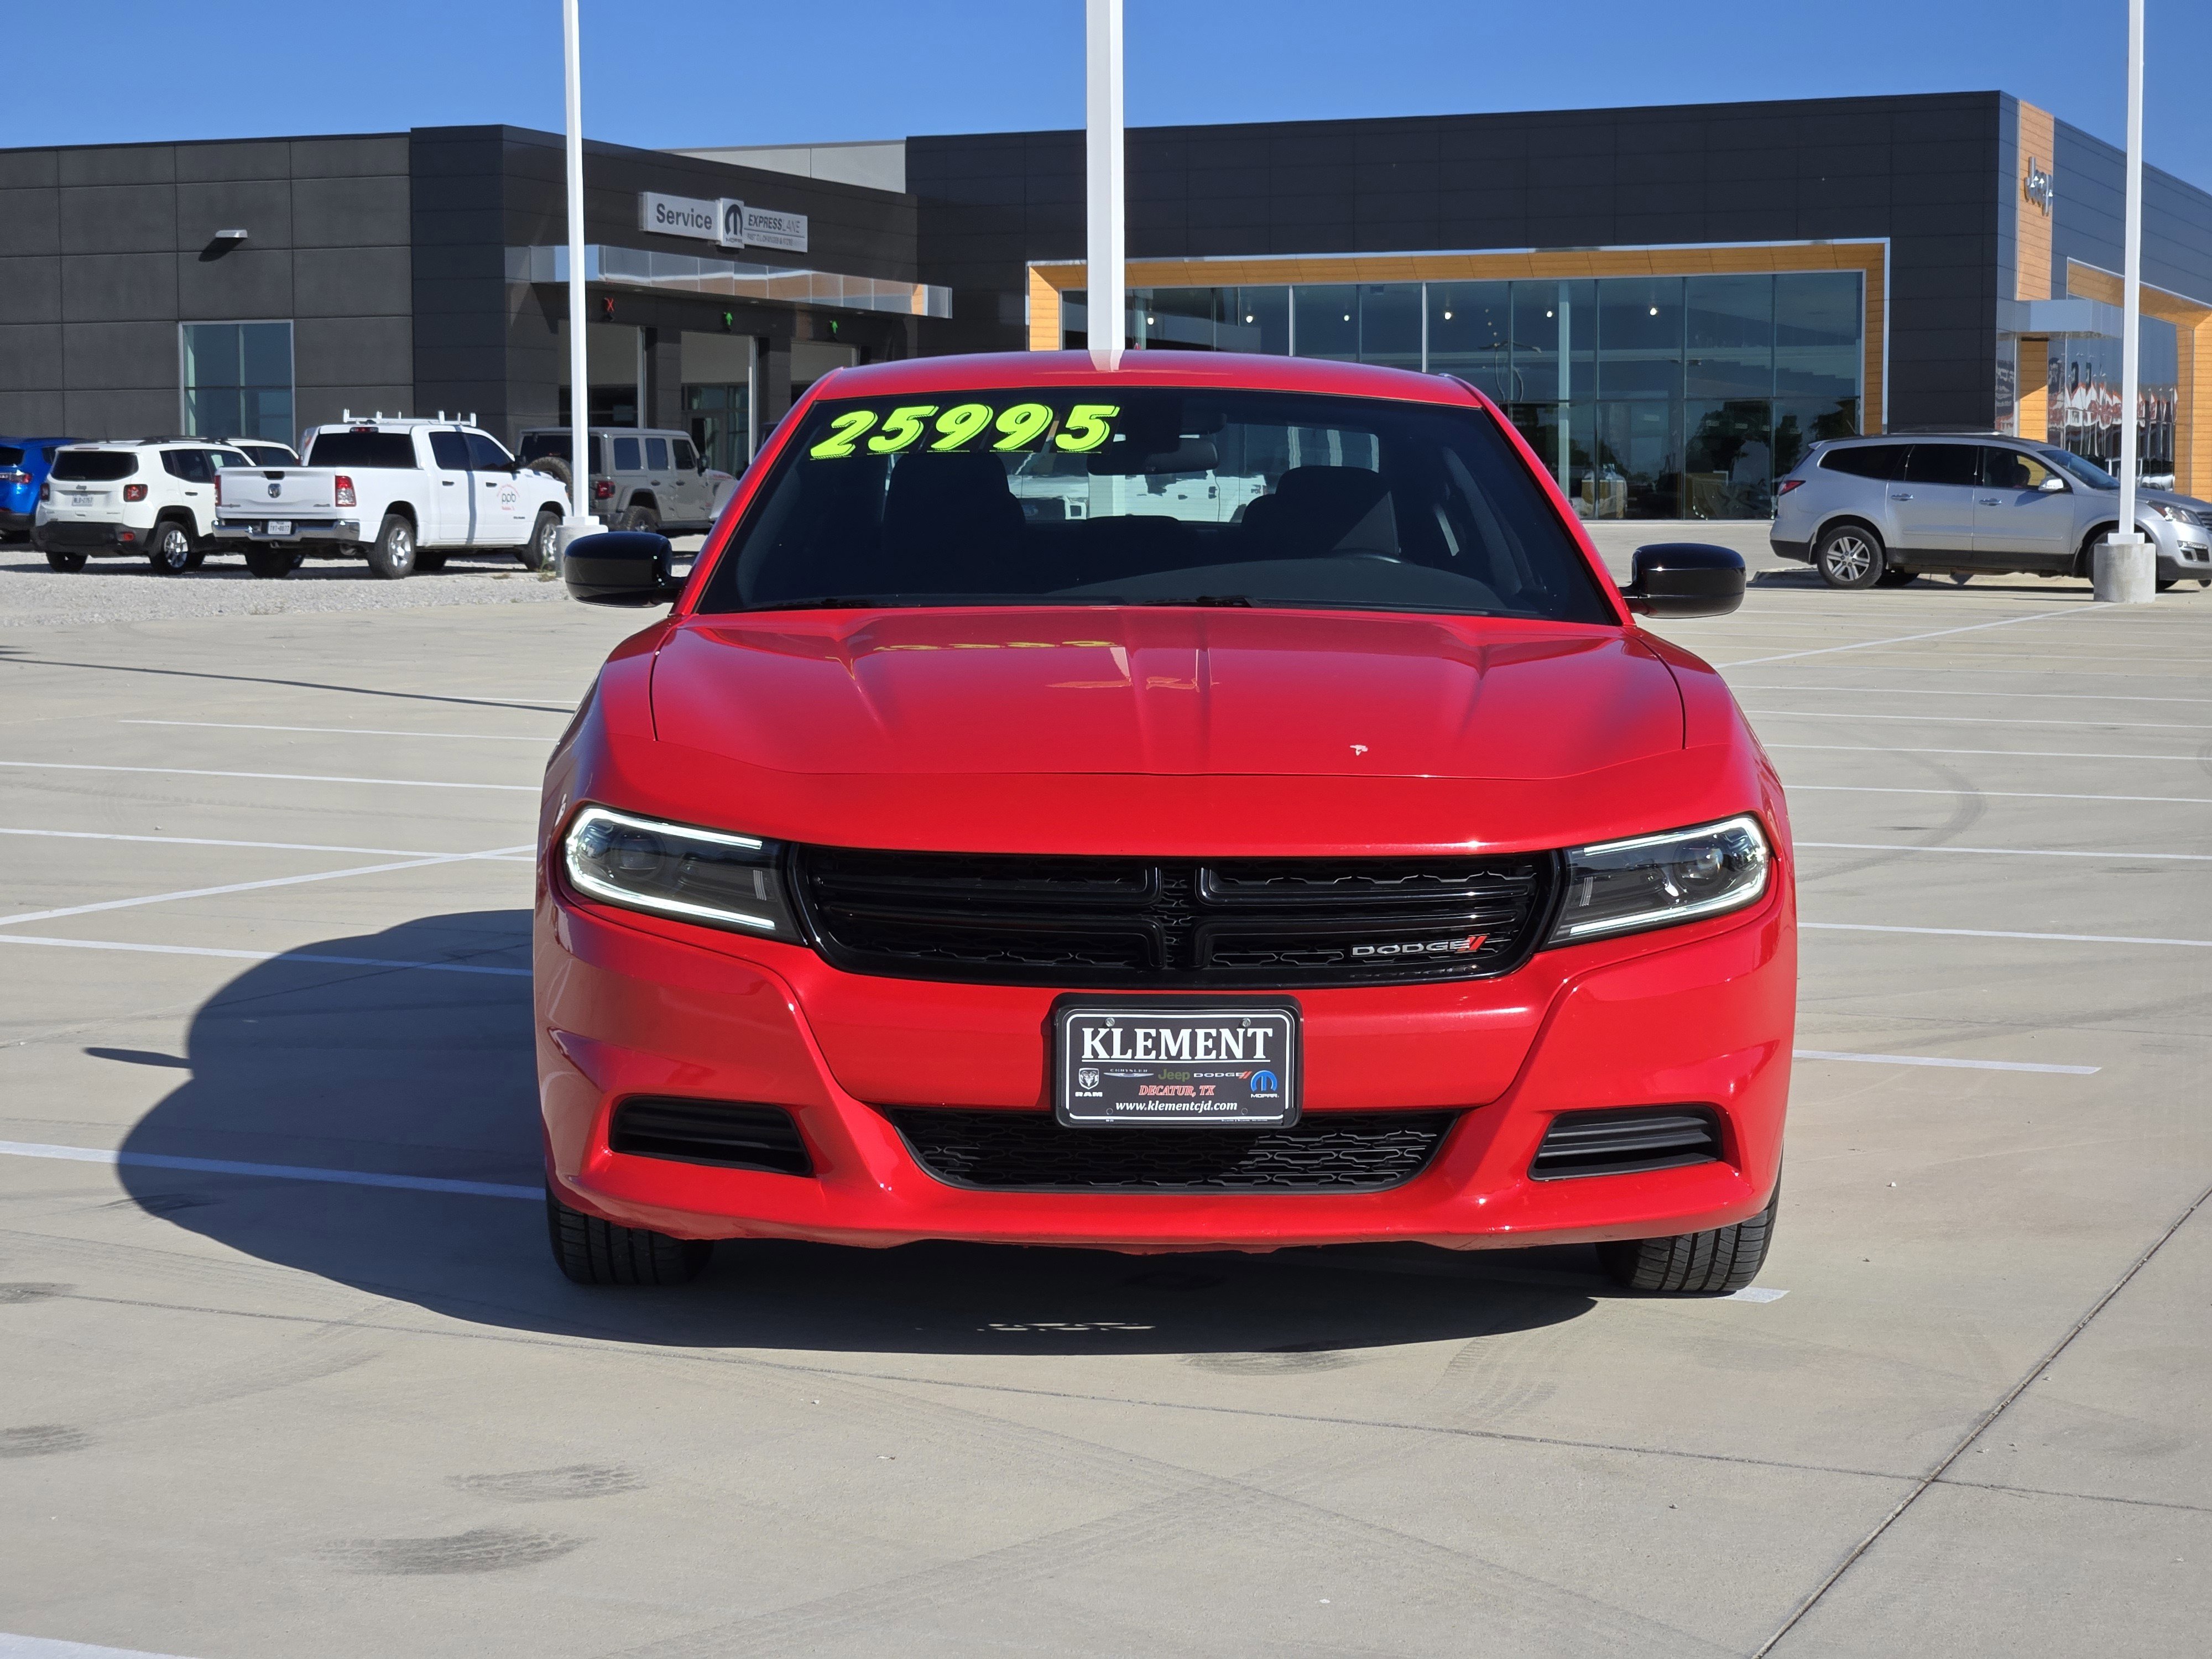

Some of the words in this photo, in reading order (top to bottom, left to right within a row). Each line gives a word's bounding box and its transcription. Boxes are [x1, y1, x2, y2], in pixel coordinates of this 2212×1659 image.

[656, 202, 712, 230] Service
[810, 404, 1120, 459] 25995
[1352, 939, 1470, 956] DODGE
[1082, 1027, 1273, 1060] KLEMENT
[1158, 1068, 1191, 1082] Jeep
[1139, 1085, 1196, 1098] DECATUR,
[1199, 1085, 1216, 1095] TX
[1115, 1100, 1238, 1113] www.klementcjd.com
